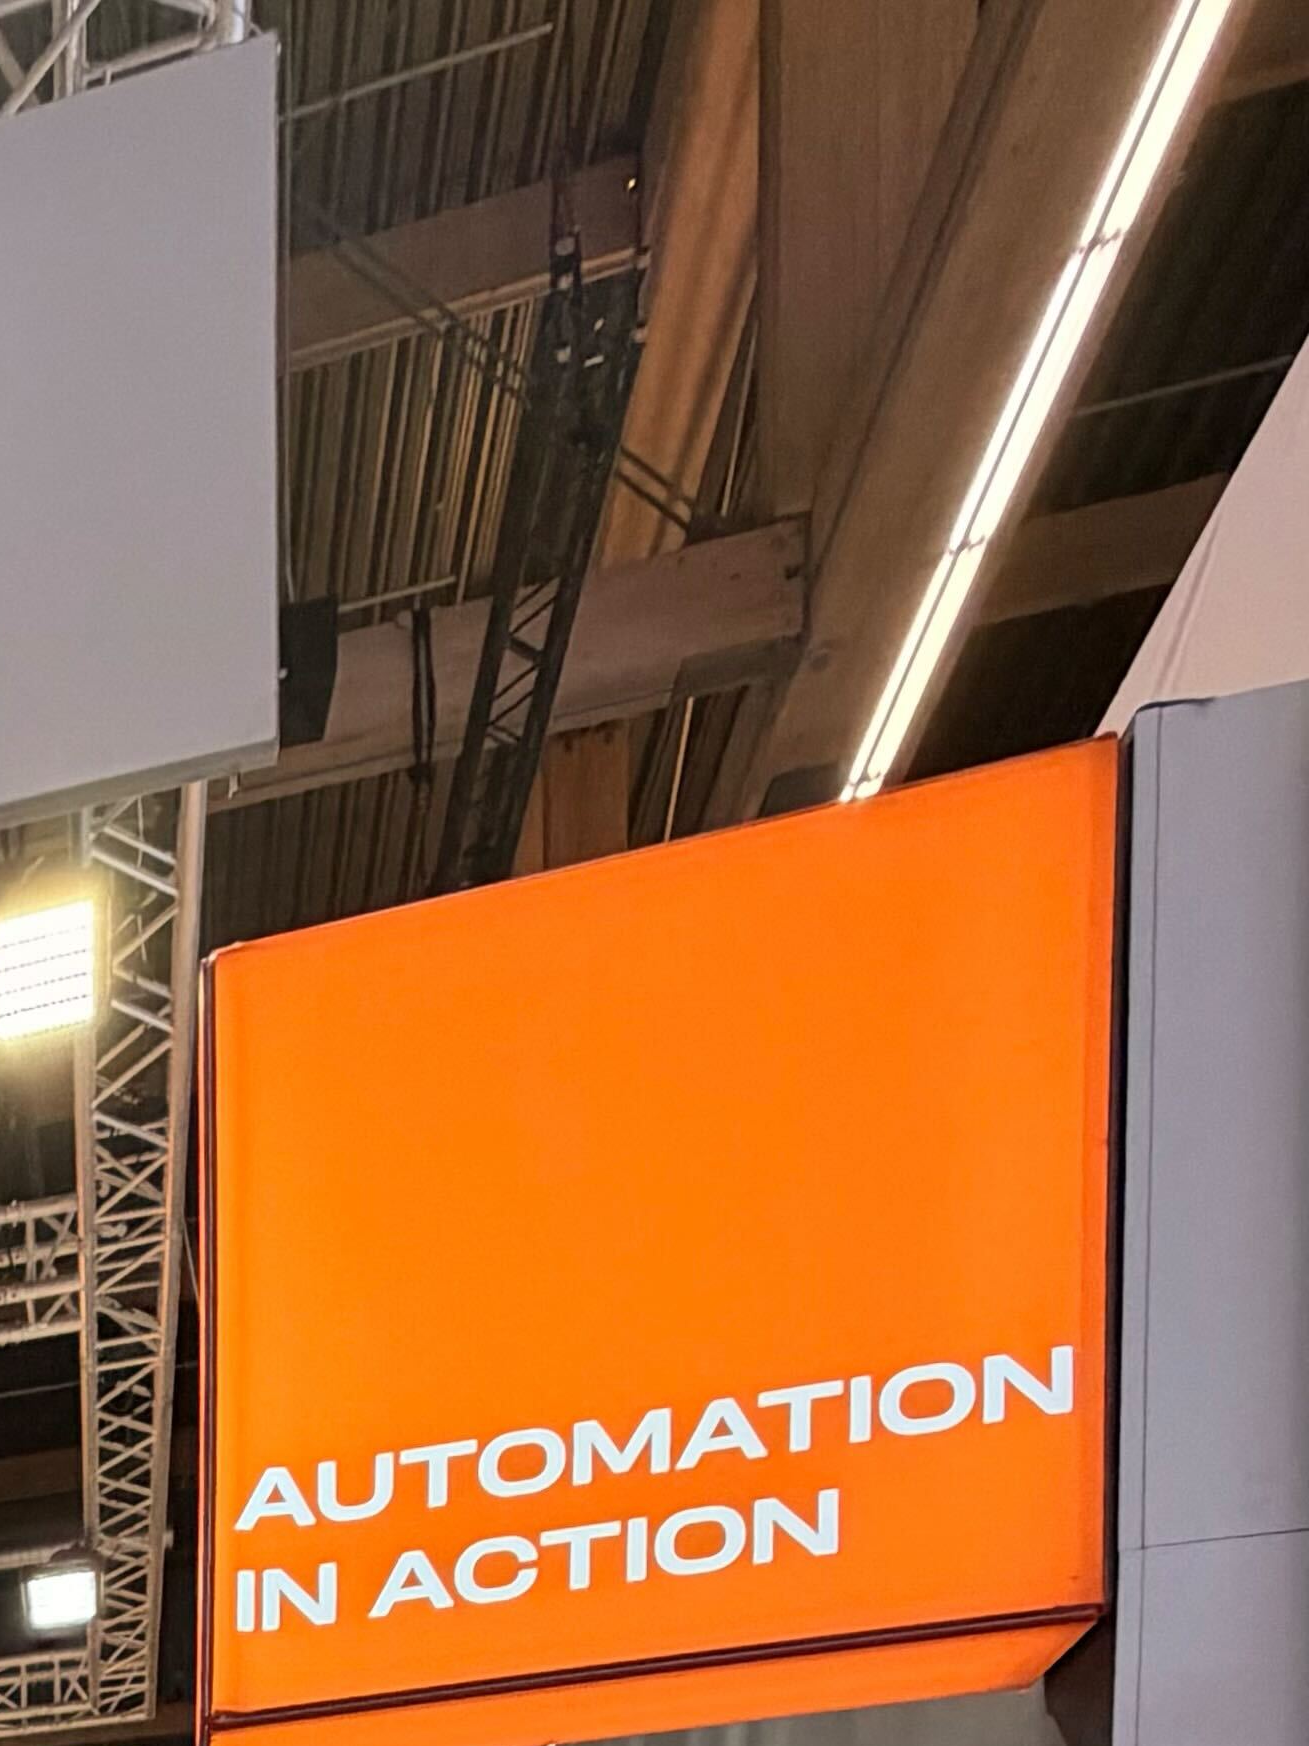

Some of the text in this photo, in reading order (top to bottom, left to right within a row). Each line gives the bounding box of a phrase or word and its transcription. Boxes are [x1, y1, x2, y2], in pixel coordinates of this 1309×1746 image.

[235, 1345, 1074, 1532] AUTOMATION
[236, 1488, 841, 1633] IN ACTION
